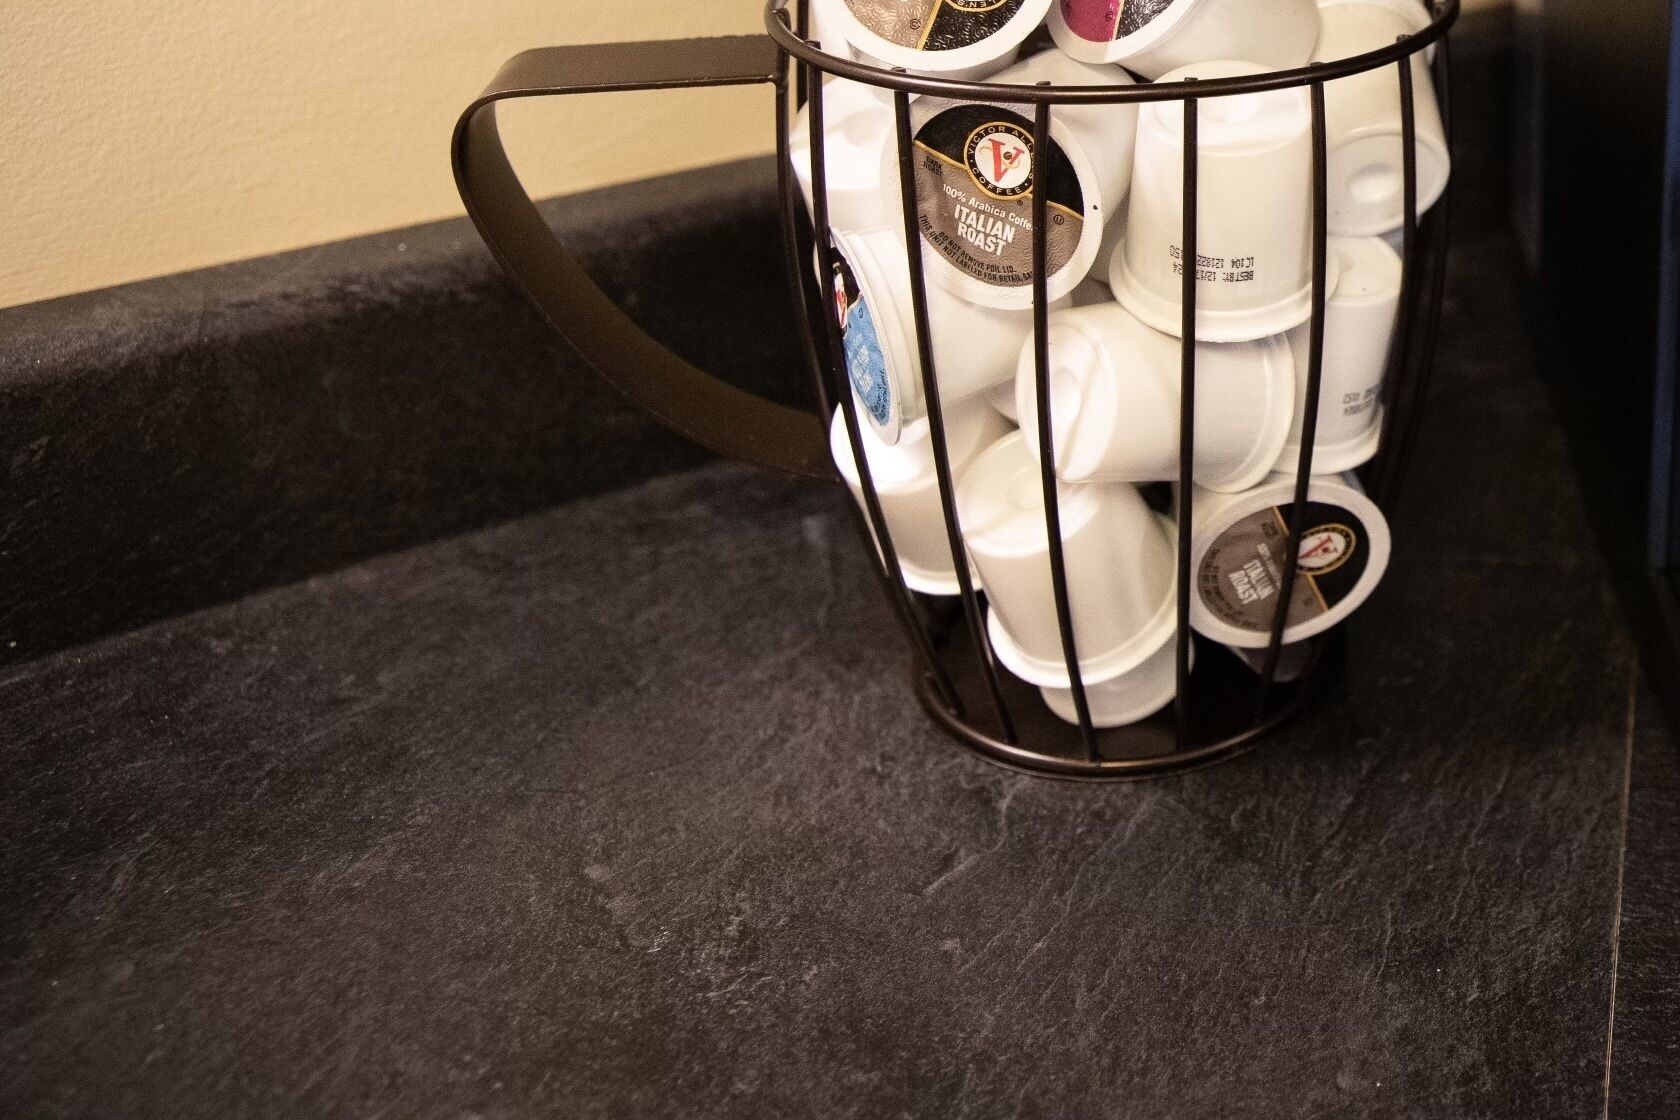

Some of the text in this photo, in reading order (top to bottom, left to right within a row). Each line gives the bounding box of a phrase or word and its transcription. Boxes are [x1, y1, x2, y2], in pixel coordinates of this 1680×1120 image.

[968, 125, 1006, 156] VICTOR
[972, 167, 1023, 196] COFFEE
[942, 183, 1033, 232] 100% Arabica Coffe
[954, 204, 1016, 244] ITALIAN
[919, 214, 933, 231] THIS
[929, 231, 945, 246] UNIT
[942, 244, 958, 260] NOT
[983, 272, 997, 281] FOR
[938, 231, 949, 241] DO
[948, 238, 962, 254] NOT
[957, 221, 1007, 256] ROAST
[1227, 569, 1259, 605] ROAST
